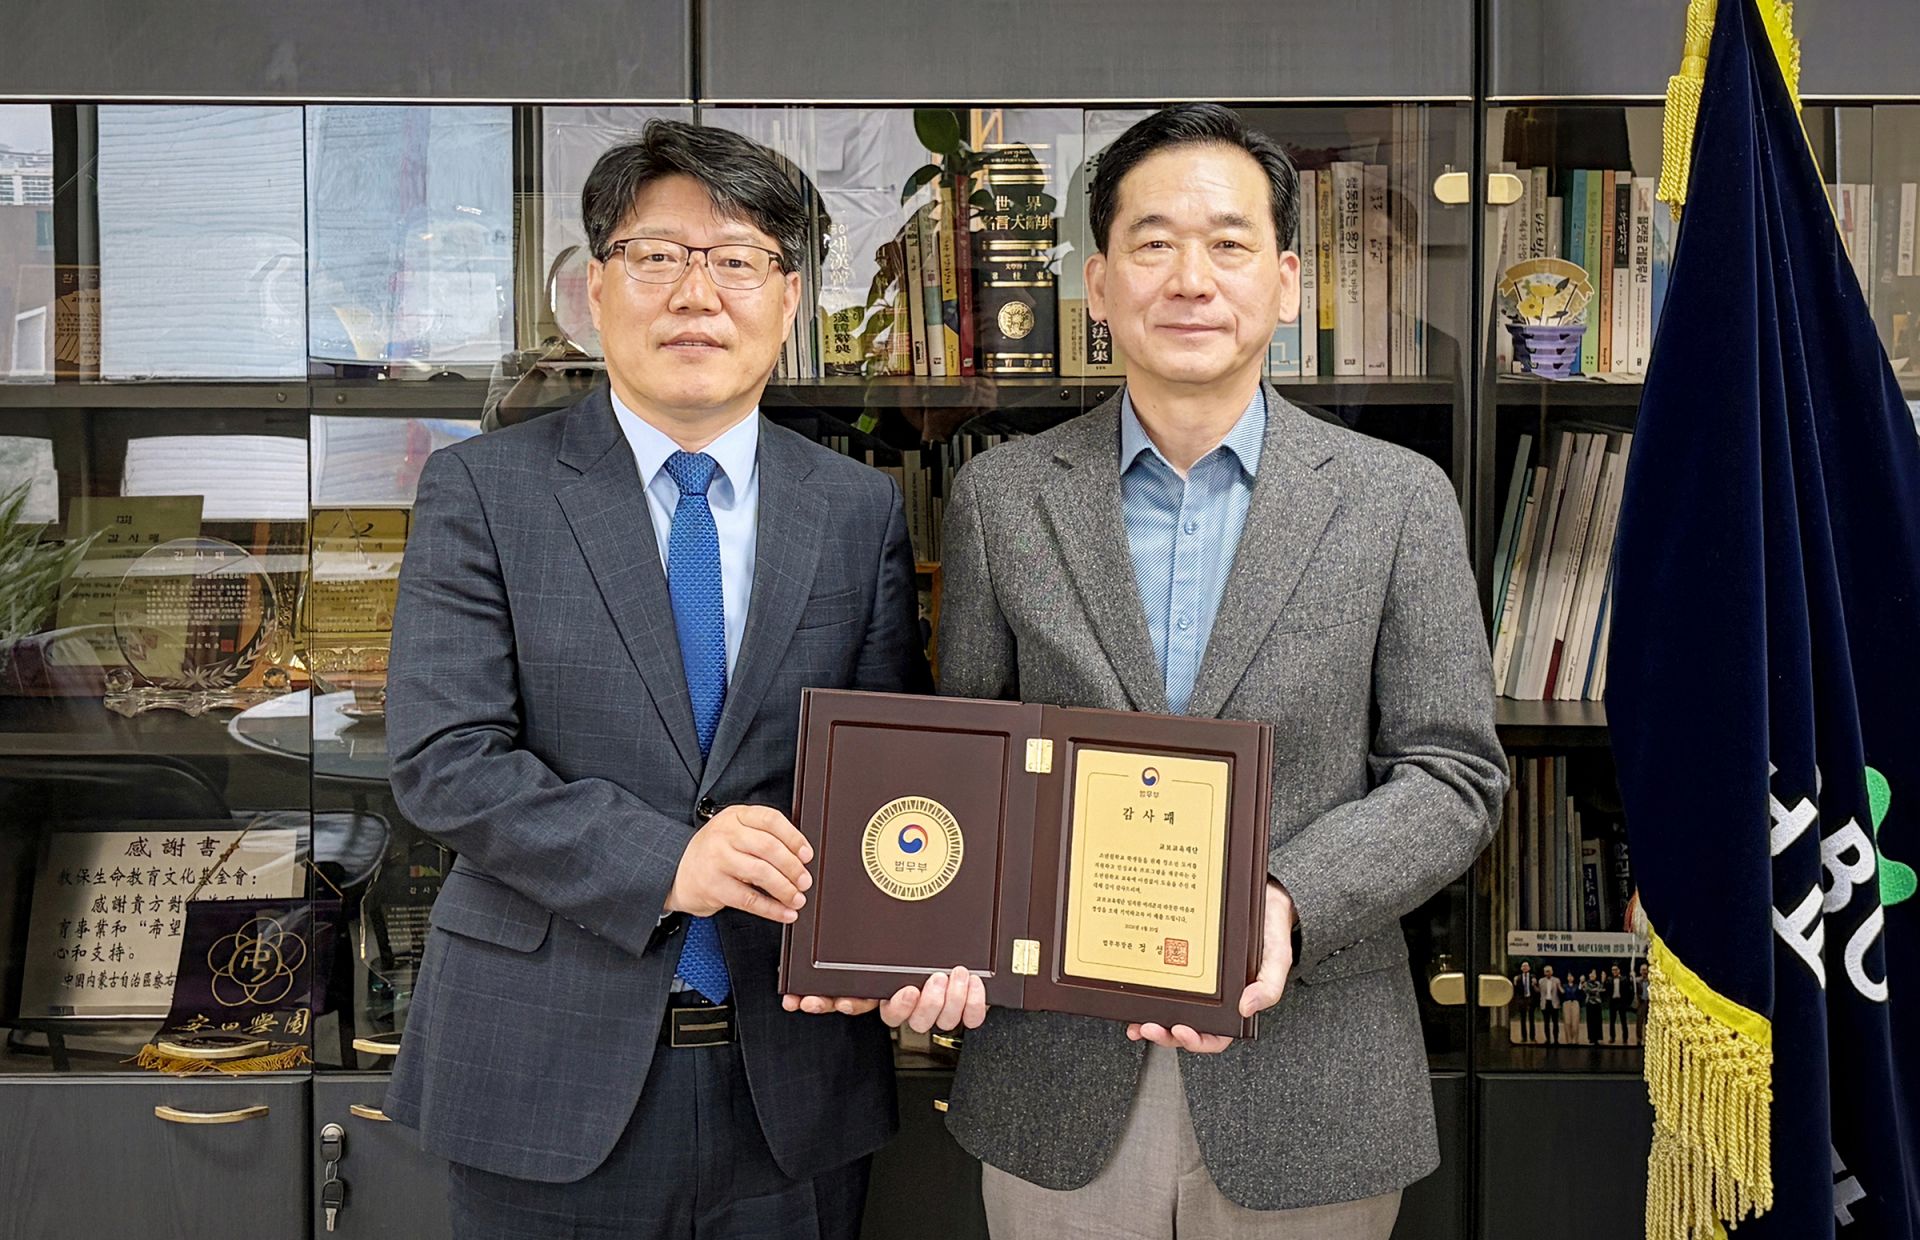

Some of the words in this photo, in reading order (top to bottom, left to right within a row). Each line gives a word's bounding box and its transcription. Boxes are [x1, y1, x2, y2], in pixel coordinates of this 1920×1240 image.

[1345, 176, 1359, 227] 행동하는
[1636, 216, 1649, 244] 플랫폼
[1345, 231, 1359, 254] 용기
[1636, 246, 1648, 283] 레볼루션
[1122, 806, 1175, 825] 감사패
[124, 835, 221, 859] 感謝書
[895, 860, 927, 873] 법무부
